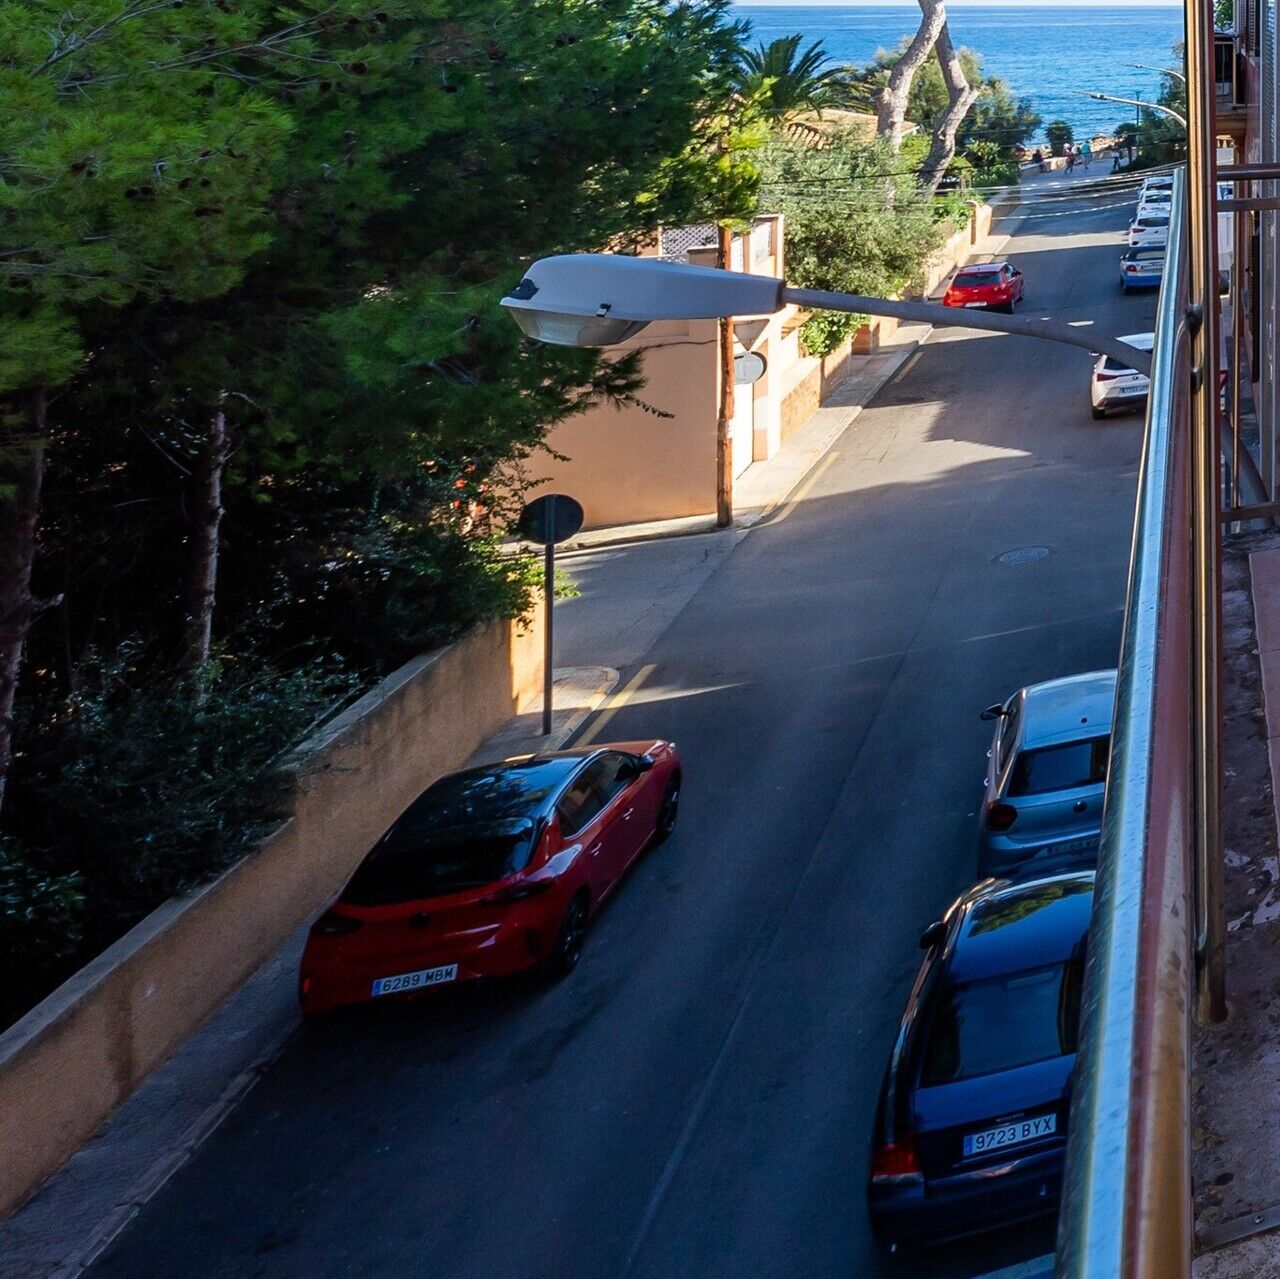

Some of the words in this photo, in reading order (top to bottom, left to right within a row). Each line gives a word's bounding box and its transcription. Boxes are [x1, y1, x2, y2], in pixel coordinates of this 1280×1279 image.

[382, 974, 420, 992] 6289
[975, 1127, 1016, 1150] 9723
[1021, 1117, 1052, 1138] BYX
